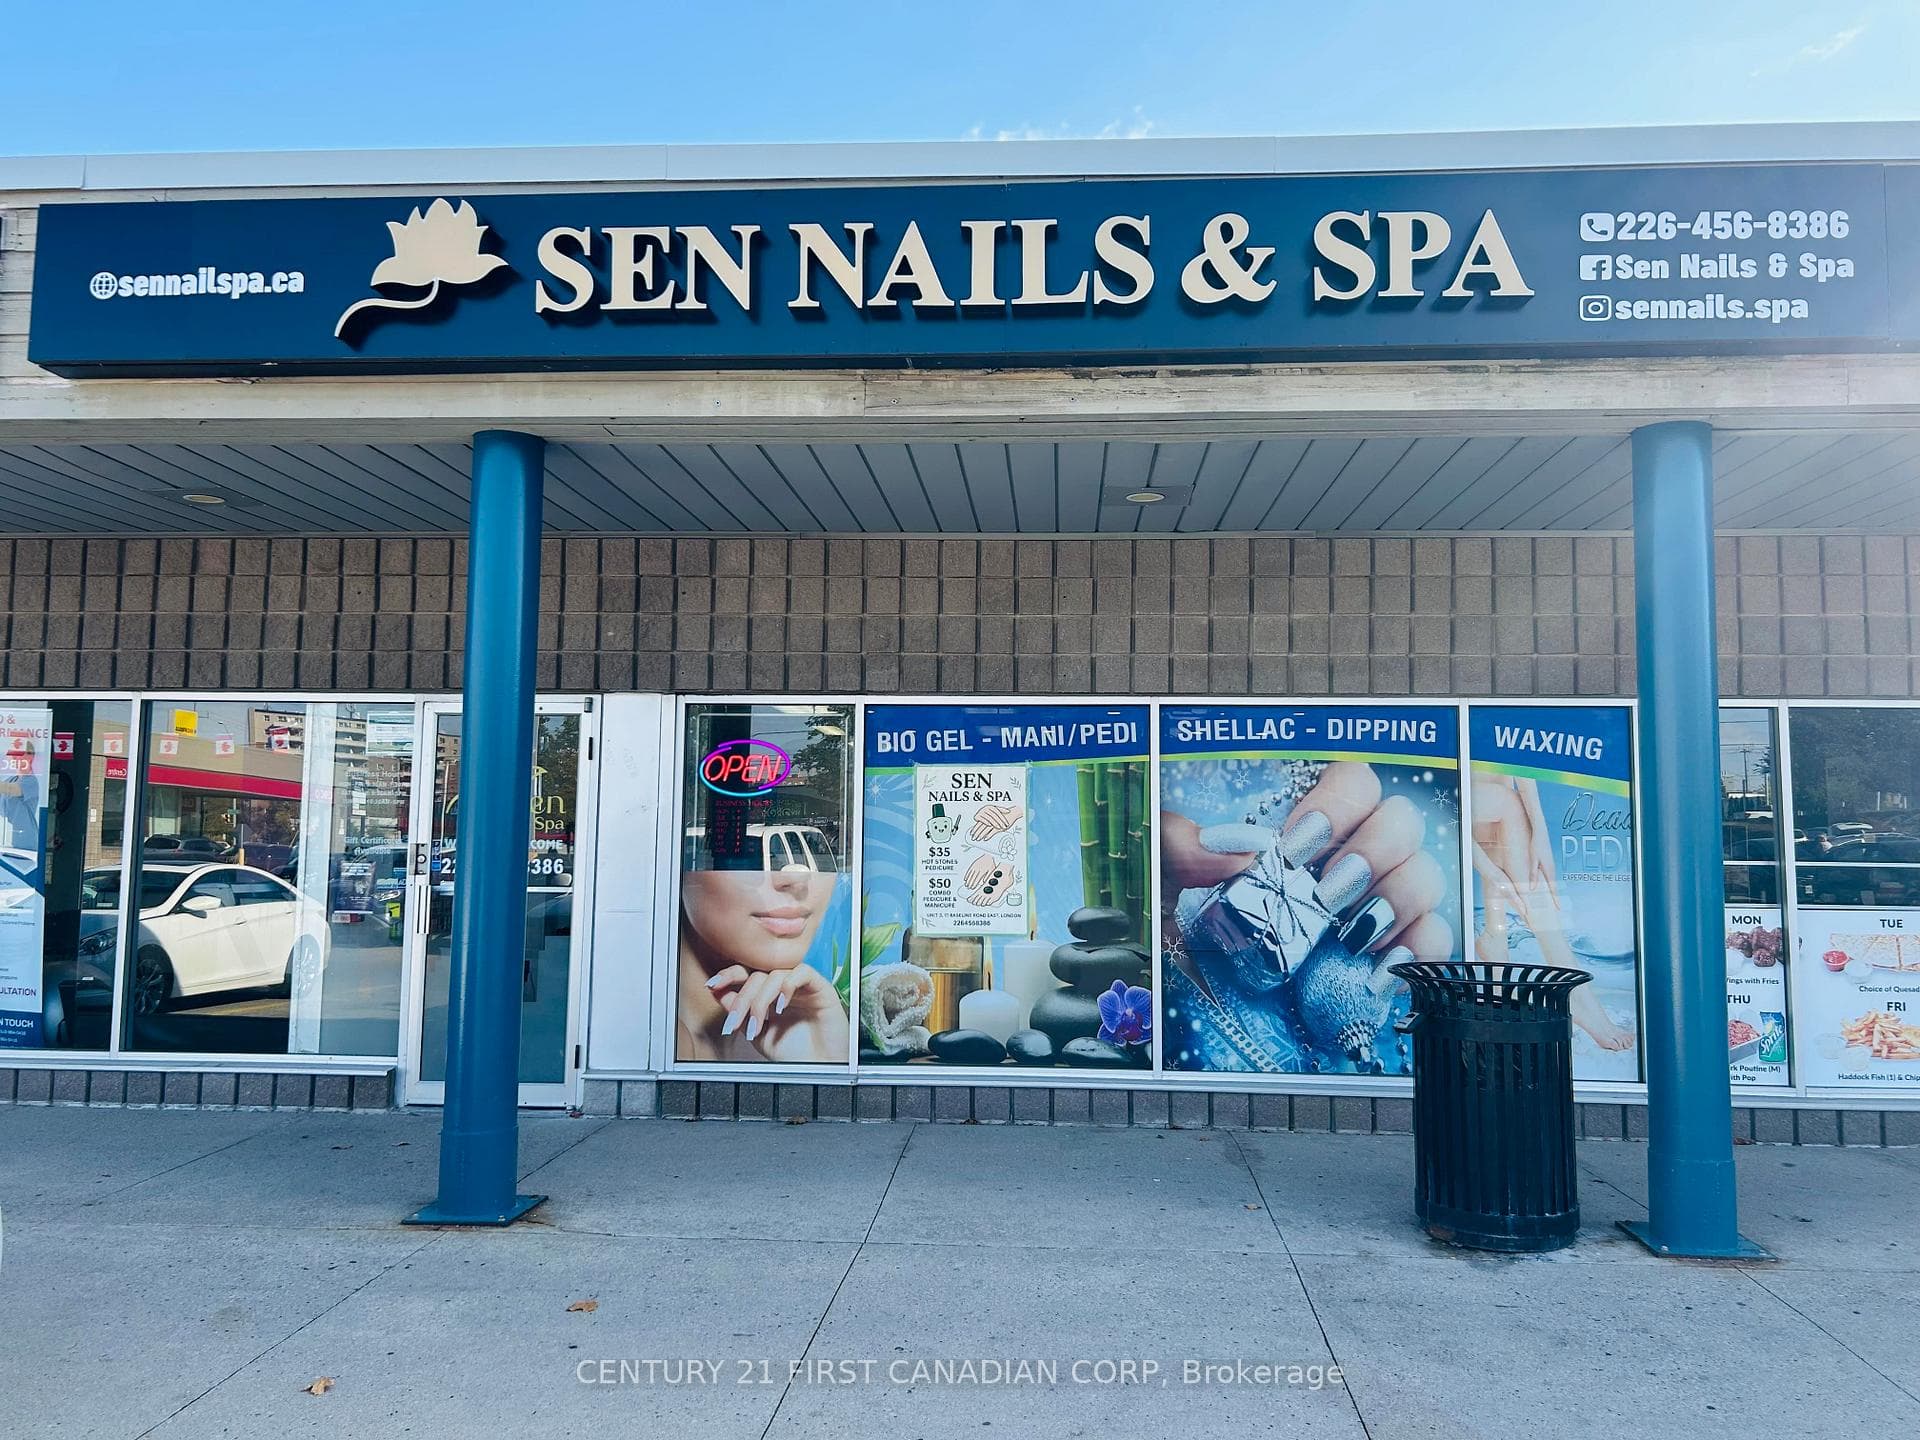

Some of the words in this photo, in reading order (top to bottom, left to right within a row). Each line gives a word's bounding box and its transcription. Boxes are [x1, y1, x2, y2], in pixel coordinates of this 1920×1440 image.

[1616, 210, 1850, 240] 226-456-8386
[533, 225, 761, 315] SEN
[787, 214, 1155, 310] NAILS
[1180, 211, 1277, 306] &
[1312, 208, 1536, 303] SPA
[1615, 254, 1670, 280] Sen
[1680, 253, 1758, 279] Nails
[1768, 252, 1788, 278] &
[1799, 252, 1855, 283] Spa
[117, 266, 305, 300] sennailspa.ca
[1615, 293, 1809, 324] sennails.spa
[877, 730, 916, 753] BIO
[925, 729, 973, 751] GEL
[1001, 721, 1137, 748] MANI/PEDI
[1177, 718, 1296, 742] SHELLAC
[1327, 718, 1437, 743] DIPPING
[1494, 725, 1604, 761] WAXING
[704, 754, 782, 783] OPEN
[951, 772, 993, 789] SEN
[927, 790, 970, 802] NAILS
[972, 790, 984, 802] &
[986, 790, 1012, 802] SPA
[535, 817, 565, 833] Spa
[928, 846, 951, 857] $35
[928, 878, 951, 889] $50
[1563, 874, 1601, 882] EXPERIENCE
[1732, 915, 1762, 925] MON
[1880, 919, 1903, 928] TUE
[1887, 1001, 1906, 1011] FRI
[4, 1018, 34, 1028] TOUCH
[1761, 1024, 1784, 1054] Sprite
[1742, 1074, 1756, 1082] Pop
